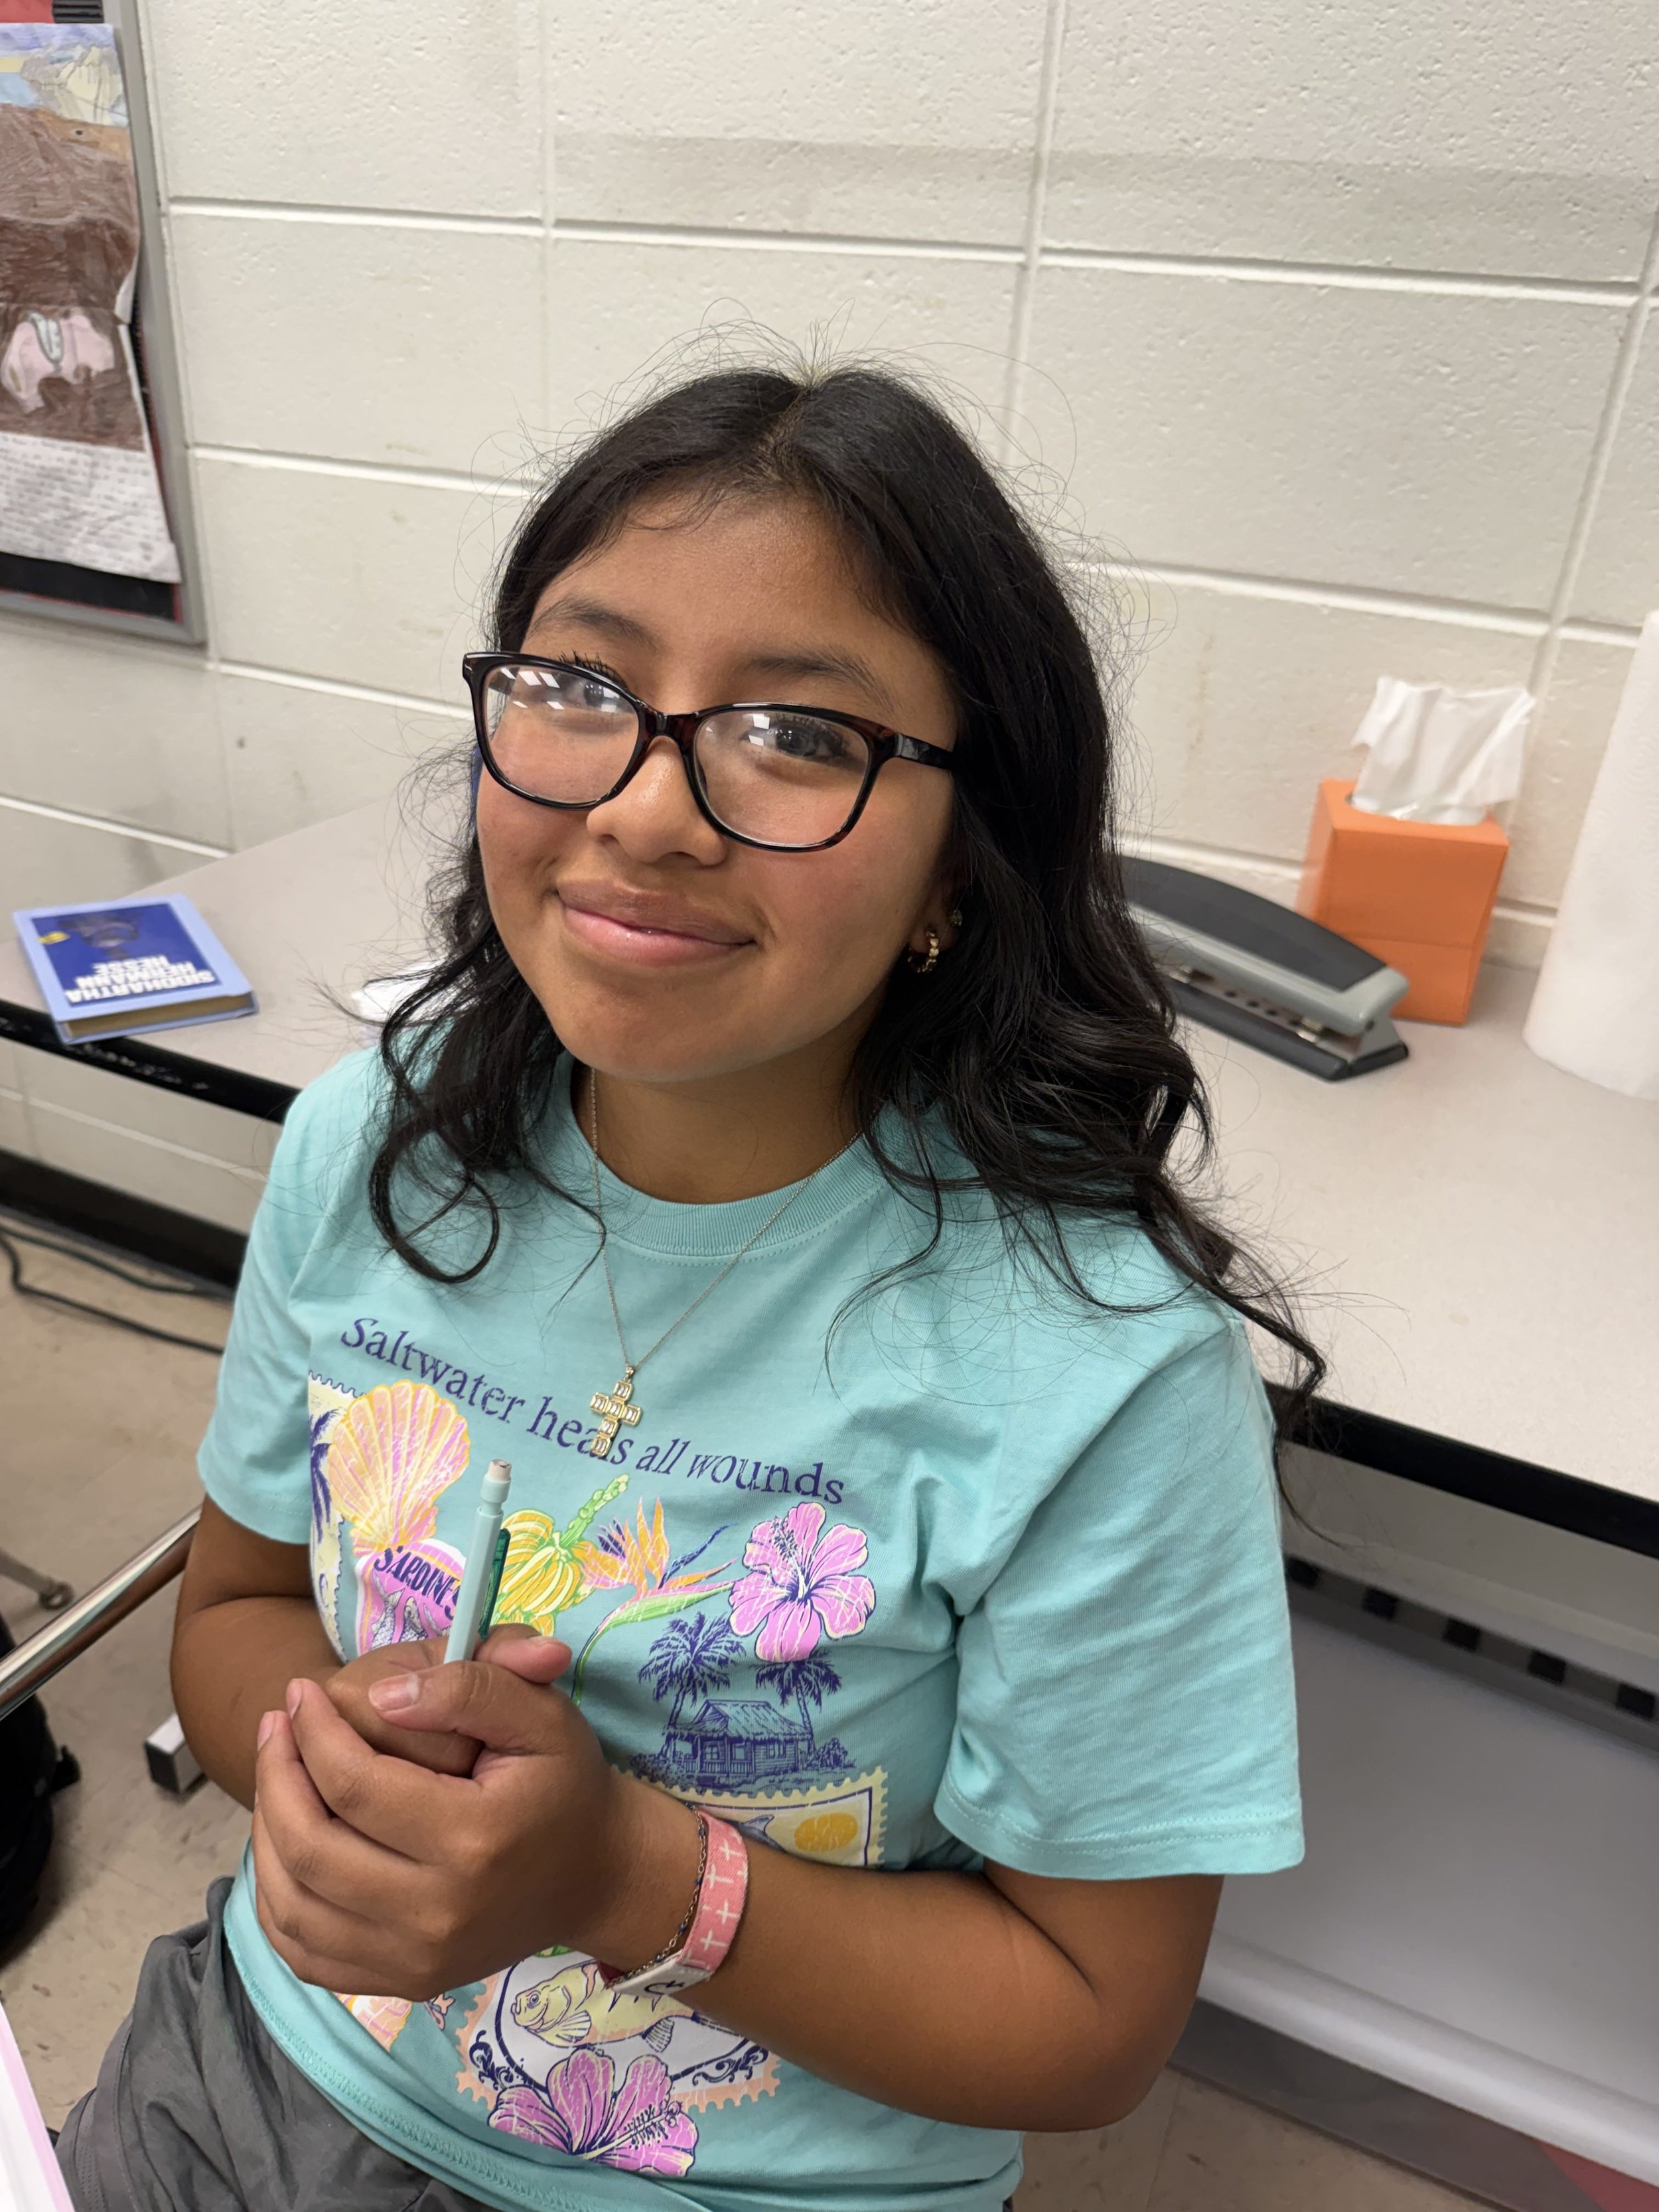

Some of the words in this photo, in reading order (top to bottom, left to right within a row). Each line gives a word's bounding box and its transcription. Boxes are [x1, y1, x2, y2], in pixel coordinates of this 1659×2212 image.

[76, 961, 196, 990] HERMANN
[92, 954, 170, 975] HESSE
[66, 970, 216, 1003] SIDDHARTHA
[340, 1317, 526, 1424] Saltwater
[526, 1396, 634, 1465] heas
[635, 1438, 691, 1475] all
[686, 1455, 845, 1505] wounds
